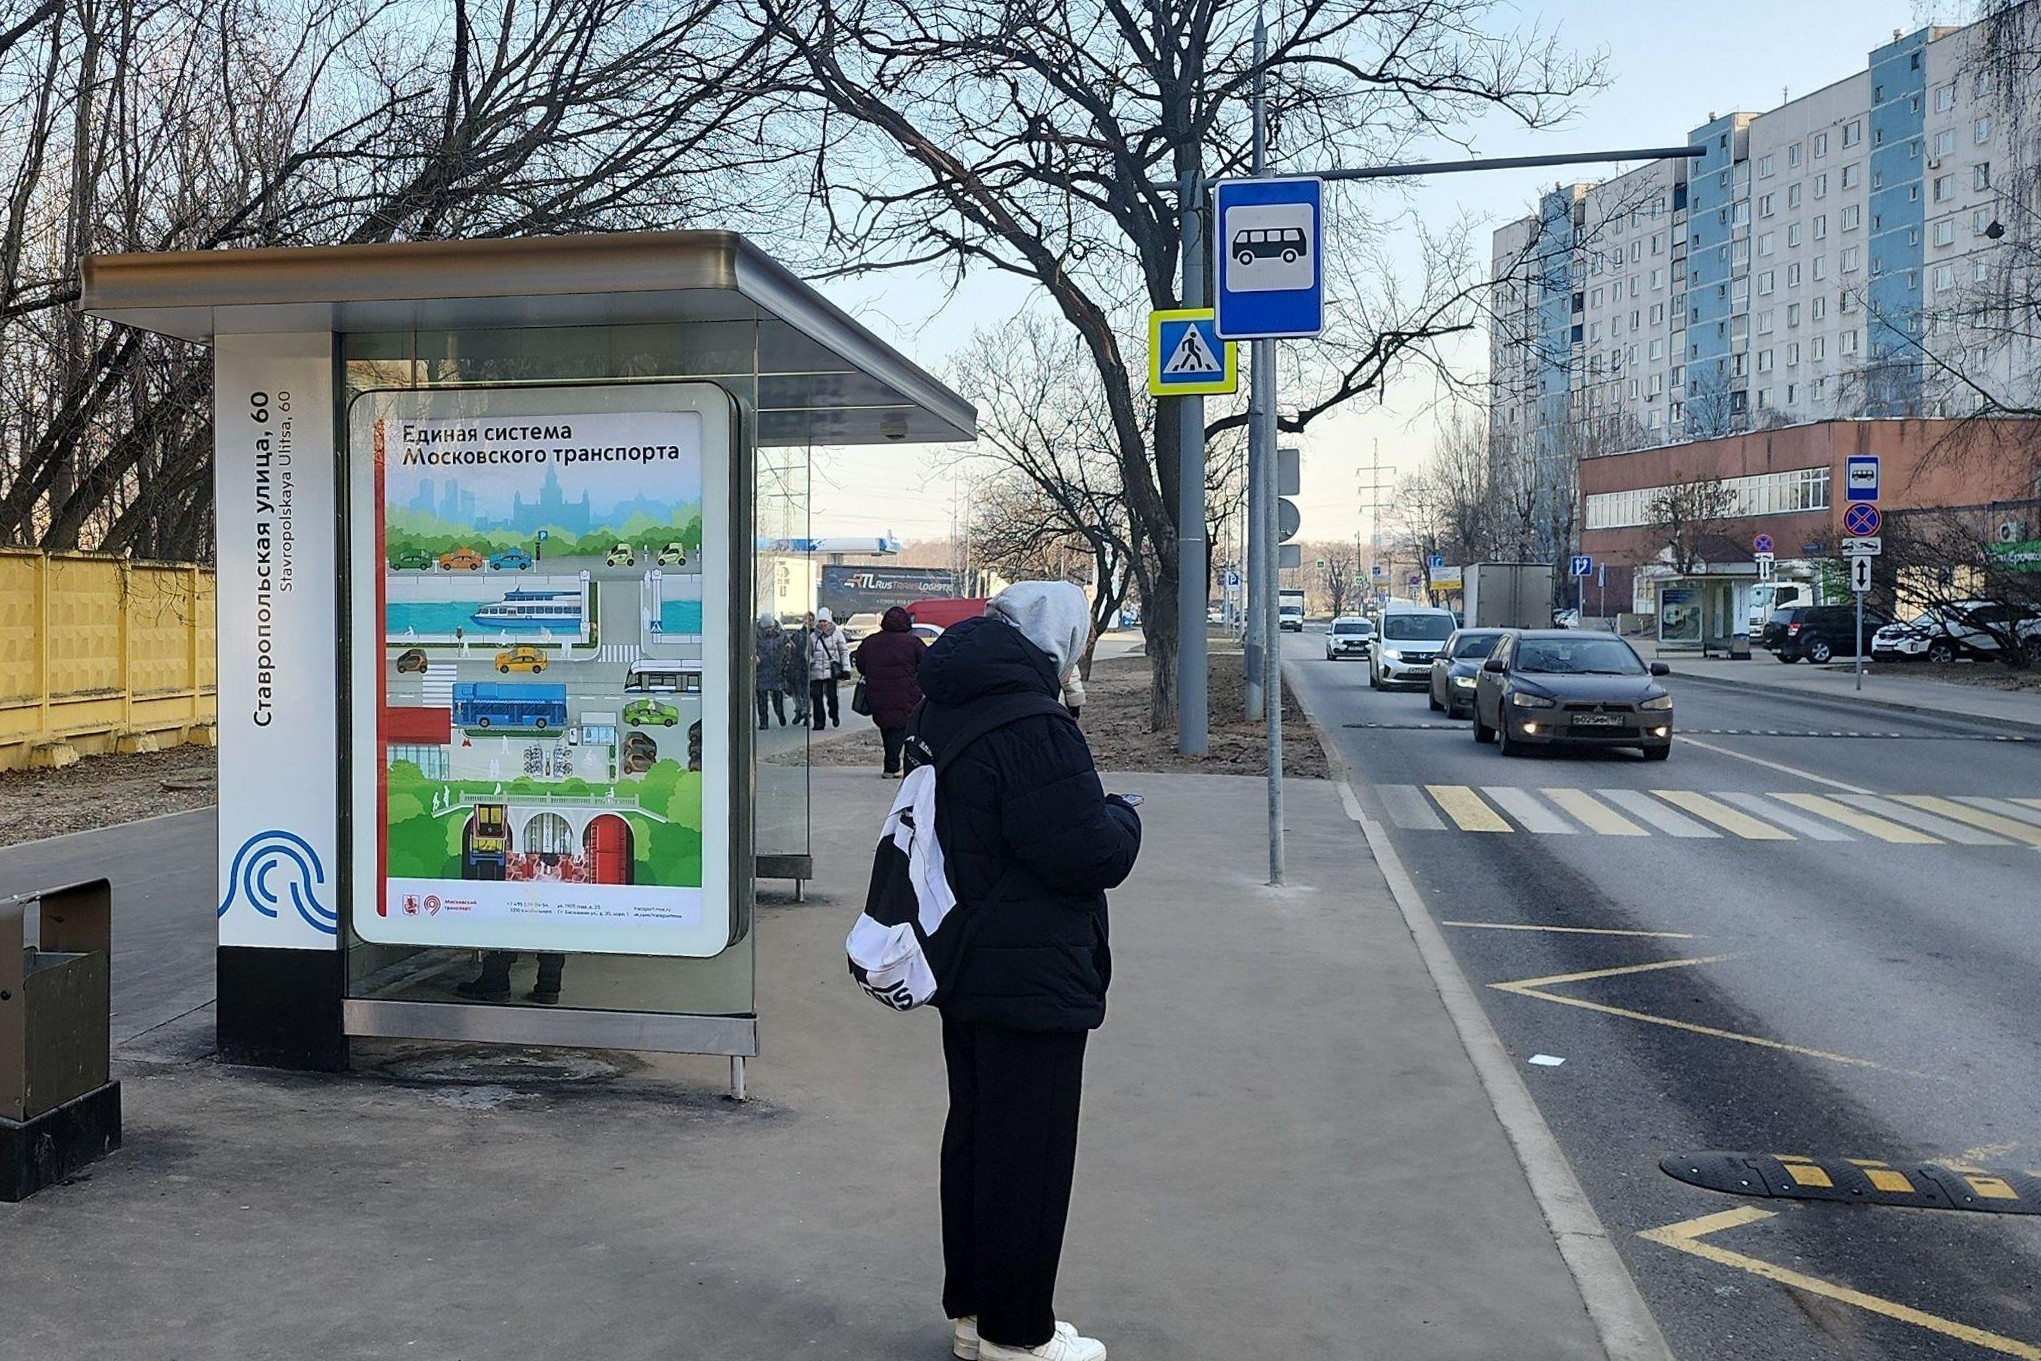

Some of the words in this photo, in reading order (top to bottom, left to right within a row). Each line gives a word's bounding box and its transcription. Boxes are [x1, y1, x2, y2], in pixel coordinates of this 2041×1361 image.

[250, 391, 269, 423] 60
[278, 390, 291, 412] 60
[278, 417, 293, 467] Ulitsa,
[402, 447, 547, 465] Московского
[553, 444, 680, 464] транспорта
[403, 425, 478, 446] Единая
[484, 425, 572, 441] система
[255, 429, 275, 514] улица,
[279, 471, 295, 592] Stavropolskaya
[254, 522, 275, 727] Ставропольская
